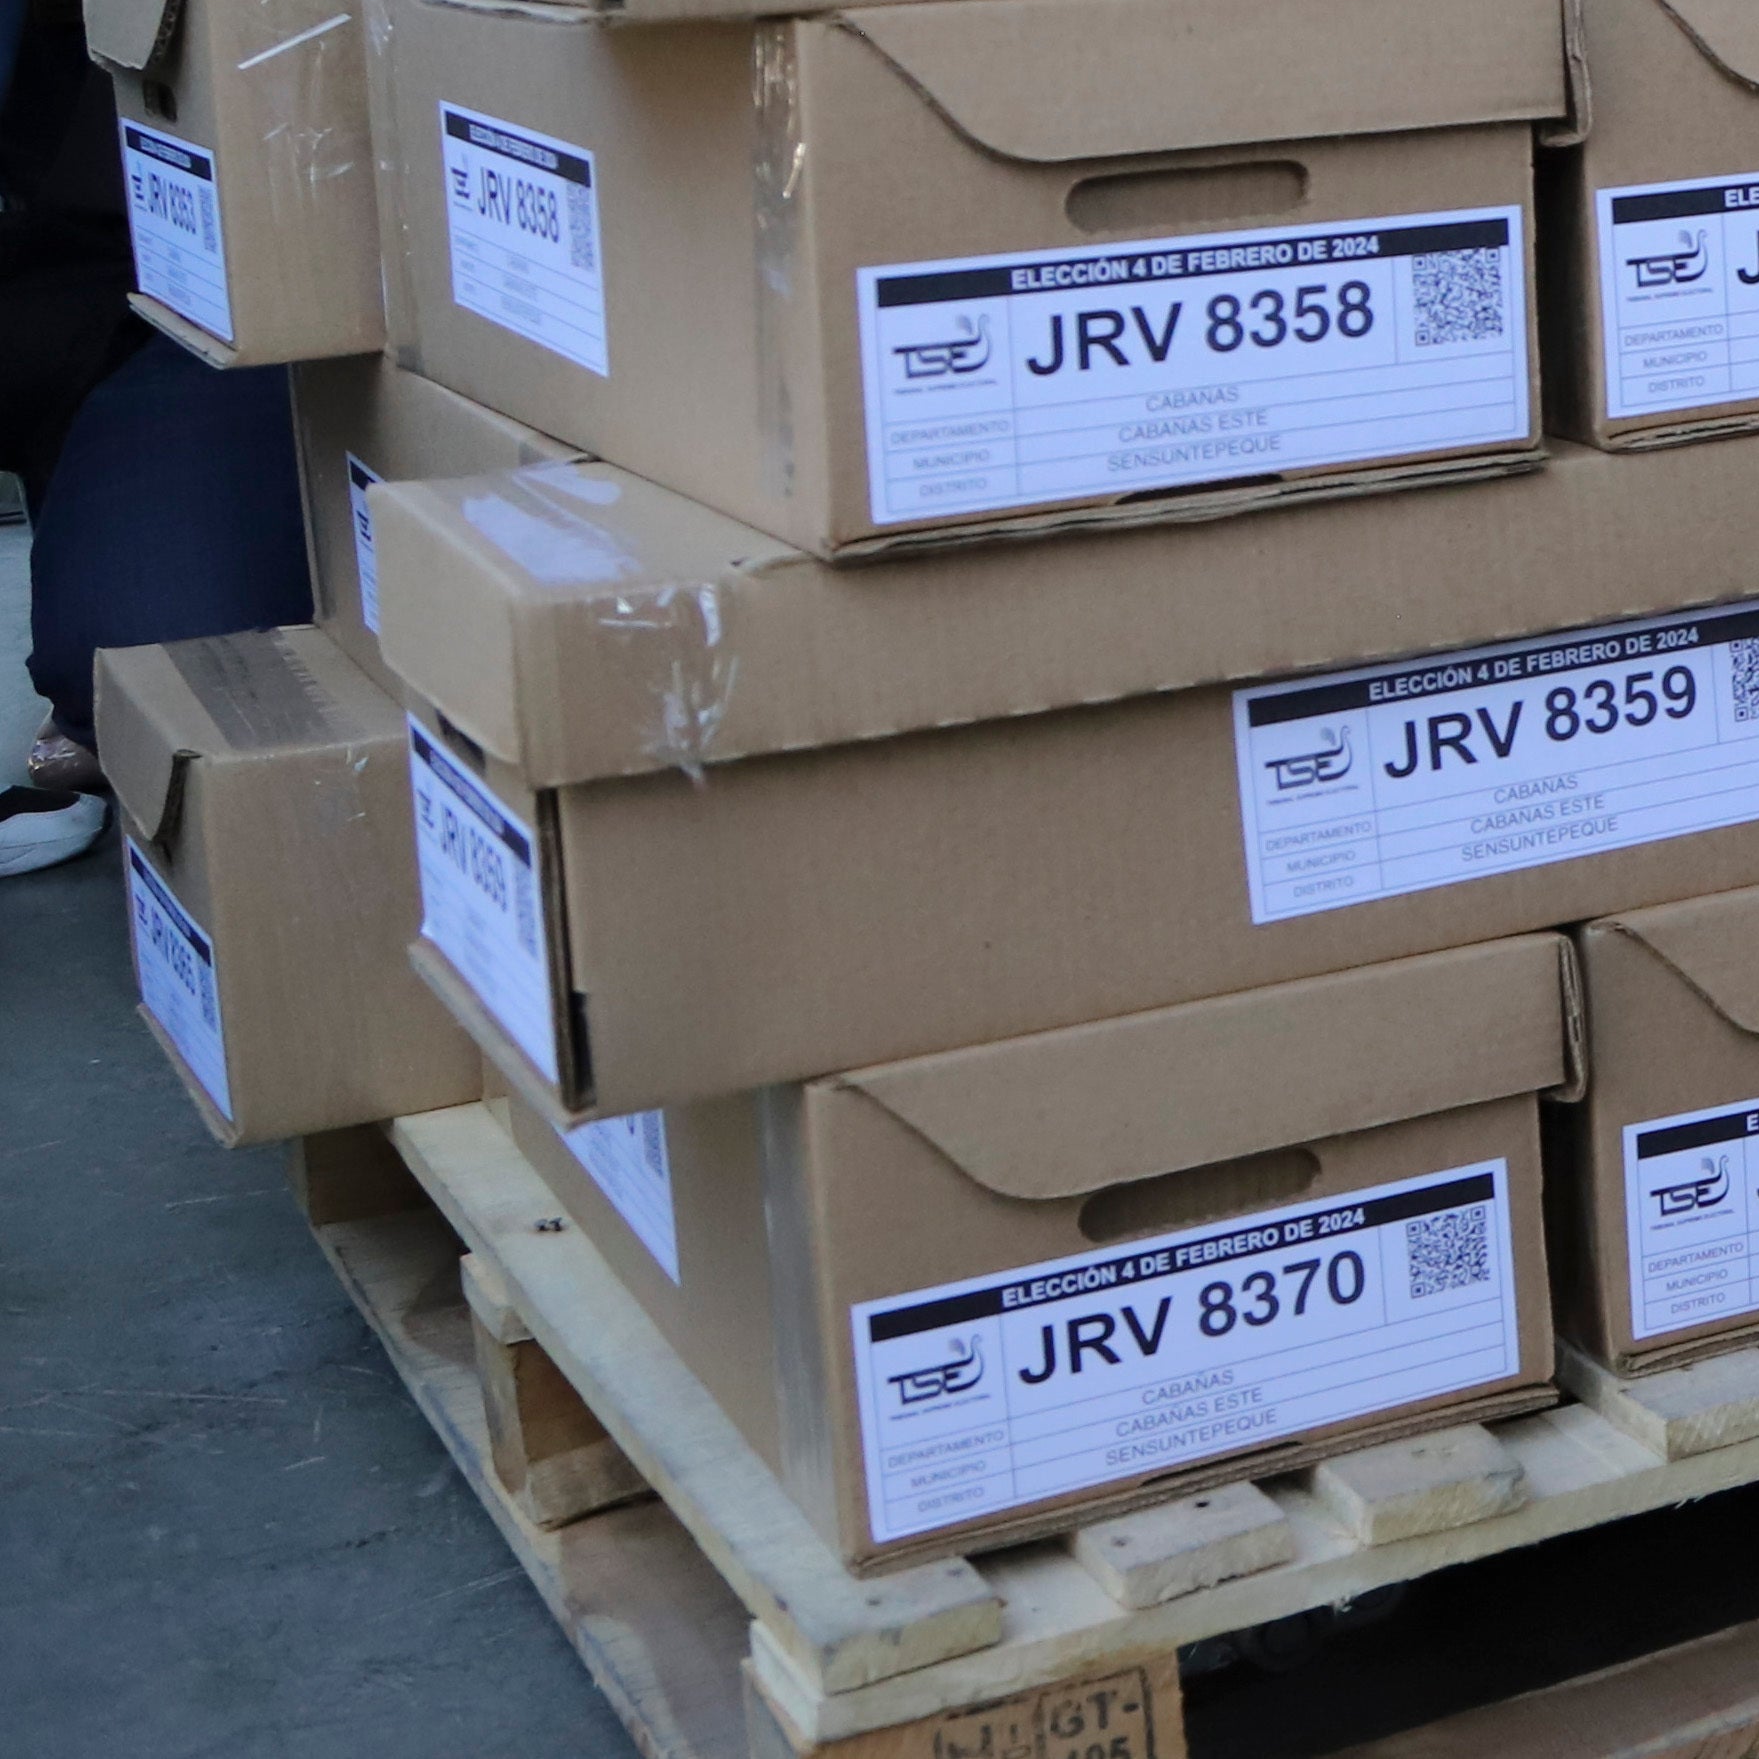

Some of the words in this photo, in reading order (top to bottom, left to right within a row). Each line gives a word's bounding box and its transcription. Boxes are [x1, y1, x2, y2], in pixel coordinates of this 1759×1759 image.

[477, 167, 512, 225] JRV
[516, 179, 559, 243] 8358
[1026, 301, 1182, 376] JRV
[1206, 279, 1374, 353] 8358
[1384, 700, 1523, 778] JRV
[1544, 664, 1696, 741] 8359
[1000, 1259, 1117, 1308] ELECCIÓN
[1119, 1258, 1135, 1281] 4
[1138, 1250, 1171, 1277] DE
[1174, 1225, 1280, 1268] FEBRERO
[1283, 1217, 1314, 1243] DE
[1317, 1205, 1366, 1235] 2024
[1018, 1295, 1172, 1384] JRV
[1198, 1249, 1365, 1337] 8370
